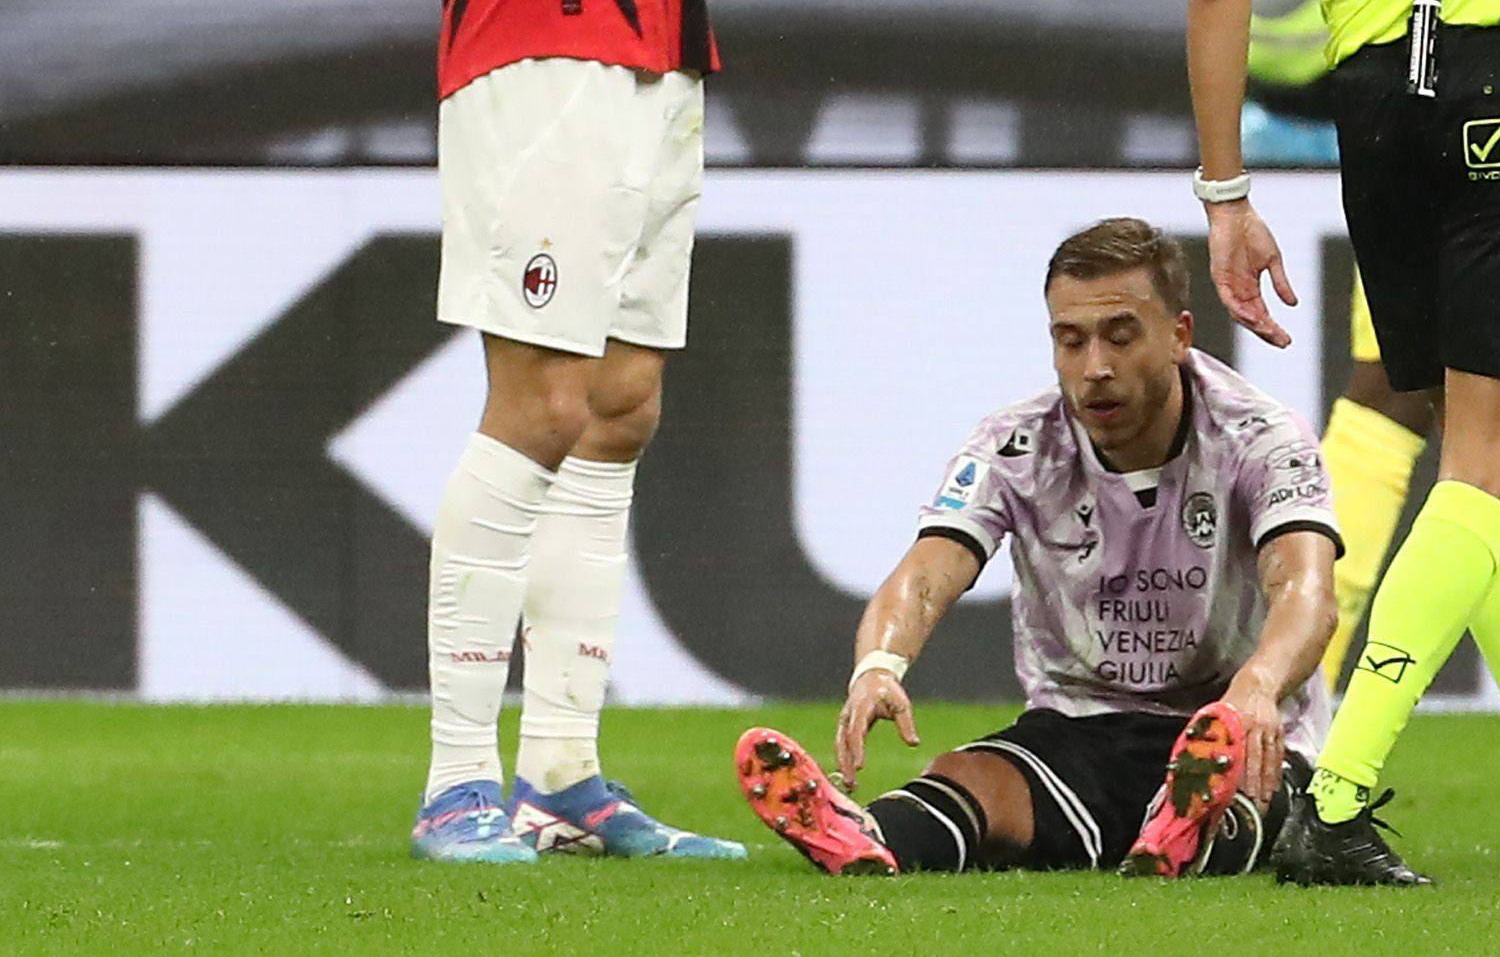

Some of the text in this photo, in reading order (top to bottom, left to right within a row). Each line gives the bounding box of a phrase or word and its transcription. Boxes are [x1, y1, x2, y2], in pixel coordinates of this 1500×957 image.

[1099, 566, 1207, 595] IO SONO
[1099, 600, 1169, 622] FRIULI
[1096, 629, 1198, 653] VENEZIA
[1095, 659, 1180, 684] GIULIA
